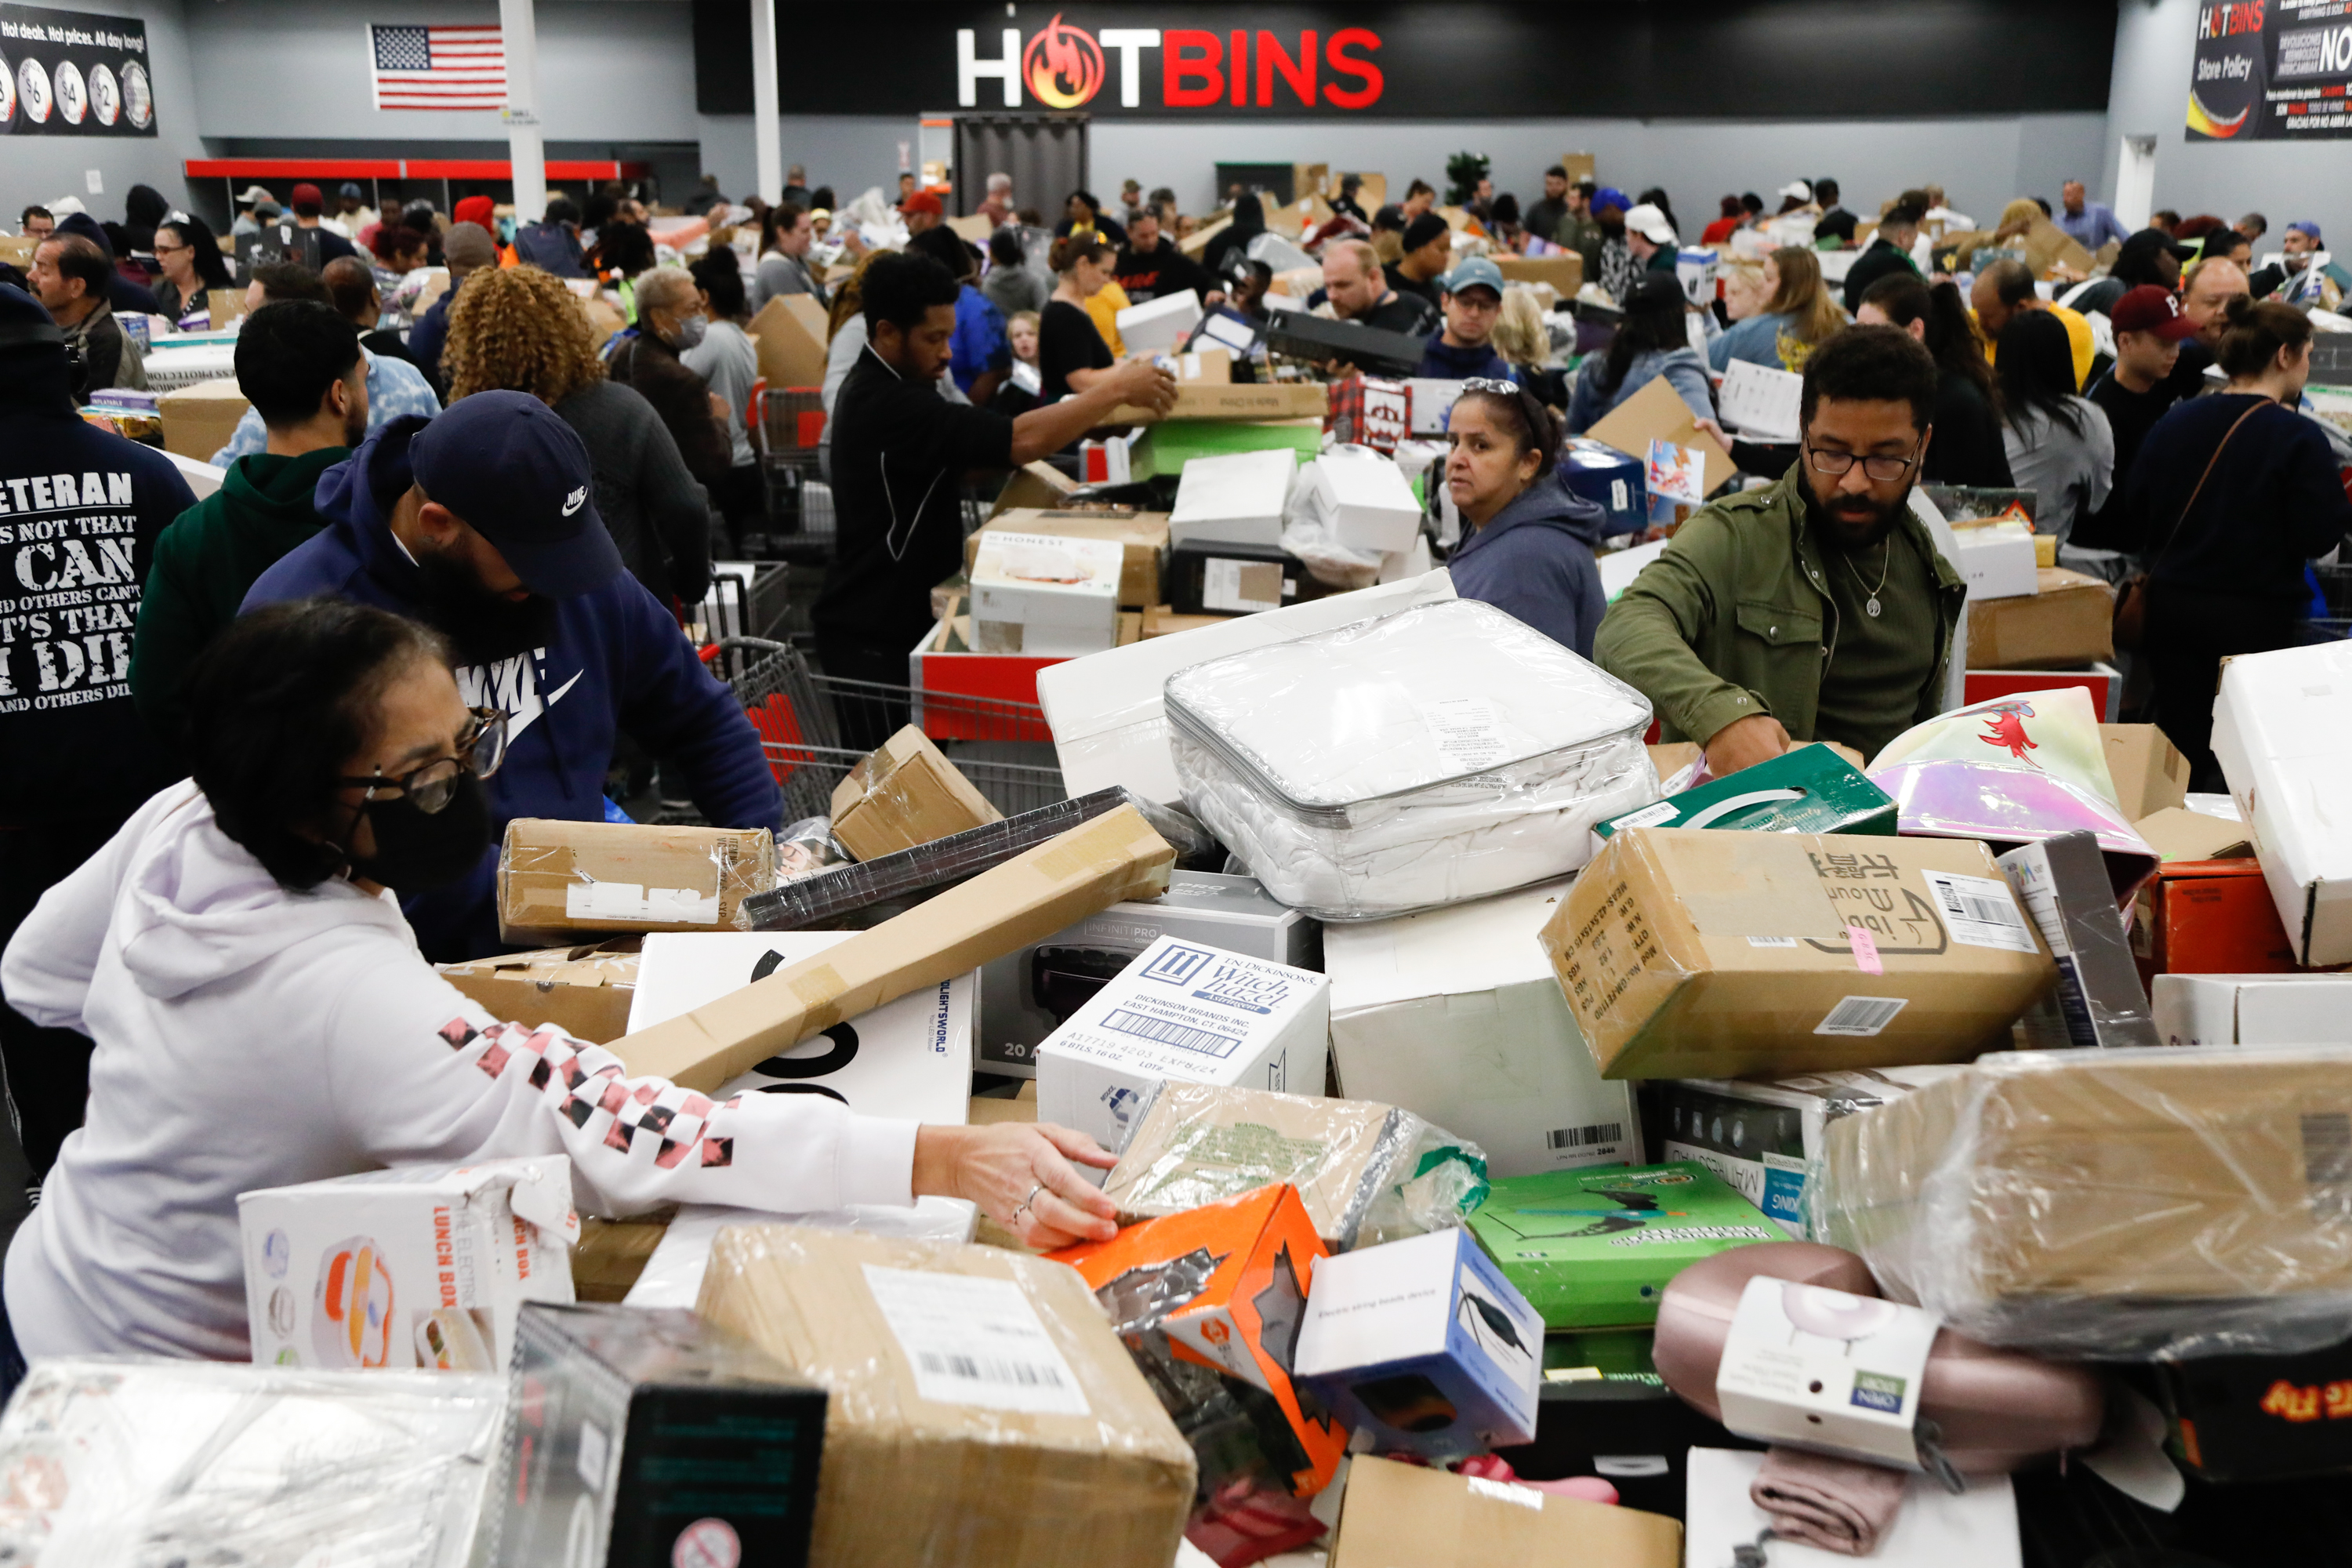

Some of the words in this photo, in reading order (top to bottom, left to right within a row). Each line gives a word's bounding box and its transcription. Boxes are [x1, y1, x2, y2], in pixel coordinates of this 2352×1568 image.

[2, 20, 19, 38] Hot
[20, 24, 48, 42] deals.
[48, 26, 64, 42] Hot
[65, 27, 94, 46] prices.
[95, 30, 107, 47] All
[107, 31, 123, 52] day
[124, 34, 145, 53] long!
[20, 60, 45, 78] MONDAY
[2198, 57, 2221, 81] Store
[2222, 54, 2252, 82] Policy
[566, 485, 586, 507] NIKE
[17, 519, 68, 541] NOT
[74, 515, 137, 535] THAT
[1003, 535, 1064, 546] HONEST
[15, 536, 136, 591] CAN
[0, 600, 16, 615] D
[20, 589, 93, 611] OTHERS
[96, 584, 141, 601] CAN'T
[0, 698, 31, 713] AND
[34, 688, 103, 710] OTHERS
[728, 837, 739, 854] ITEM
[1563, 945, 1575, 962] CM
[1641, 944, 1658, 967] Mod
[1213, 965, 1290, 996] Witch
[1567, 961, 1581, 982] KGS
[1574, 977, 1588, 996] KGS
[1134, 993, 1189, 1013] DICKINSON
[1188, 1007, 1230, 1023] BRANDS
[1231, 1018, 1250, 1029] INC.
[1204, 993, 1261, 1012] Astringent
[1123, 1000, 1149, 1011] EAST
[1150, 1006, 1200, 1026] HAMPTON,
[1200, 1018, 1217, 1029] CT.
[1216, 1022, 1250, 1038] 06424
[1004, 1043, 1025, 1057] 20
[1066, 1042, 1093, 1054] BTLS.
[1094, 1049, 1107, 1058] 16
[1108, 1053, 1123, 1062] OZ.
[1067, 1032, 1116, 1051] A17719
[1120, 1045, 1154, 1059] 4203
[1771, 1193, 1801, 1213] KING
[434, 1206, 454, 1267] LUNCH
[516, 1247, 531, 1281] BOX
[438, 1272, 458, 1308] BOX
[1318, 1305, 1349, 1319] Electric
[1352, 1299, 1377, 1312] string
[1377, 1293, 1406, 1306] beads
[1406, 1288, 1436, 1301] device
[1856, 1388, 1897, 1410] OPEN
[2258, 1378, 2321, 1423] Fly
